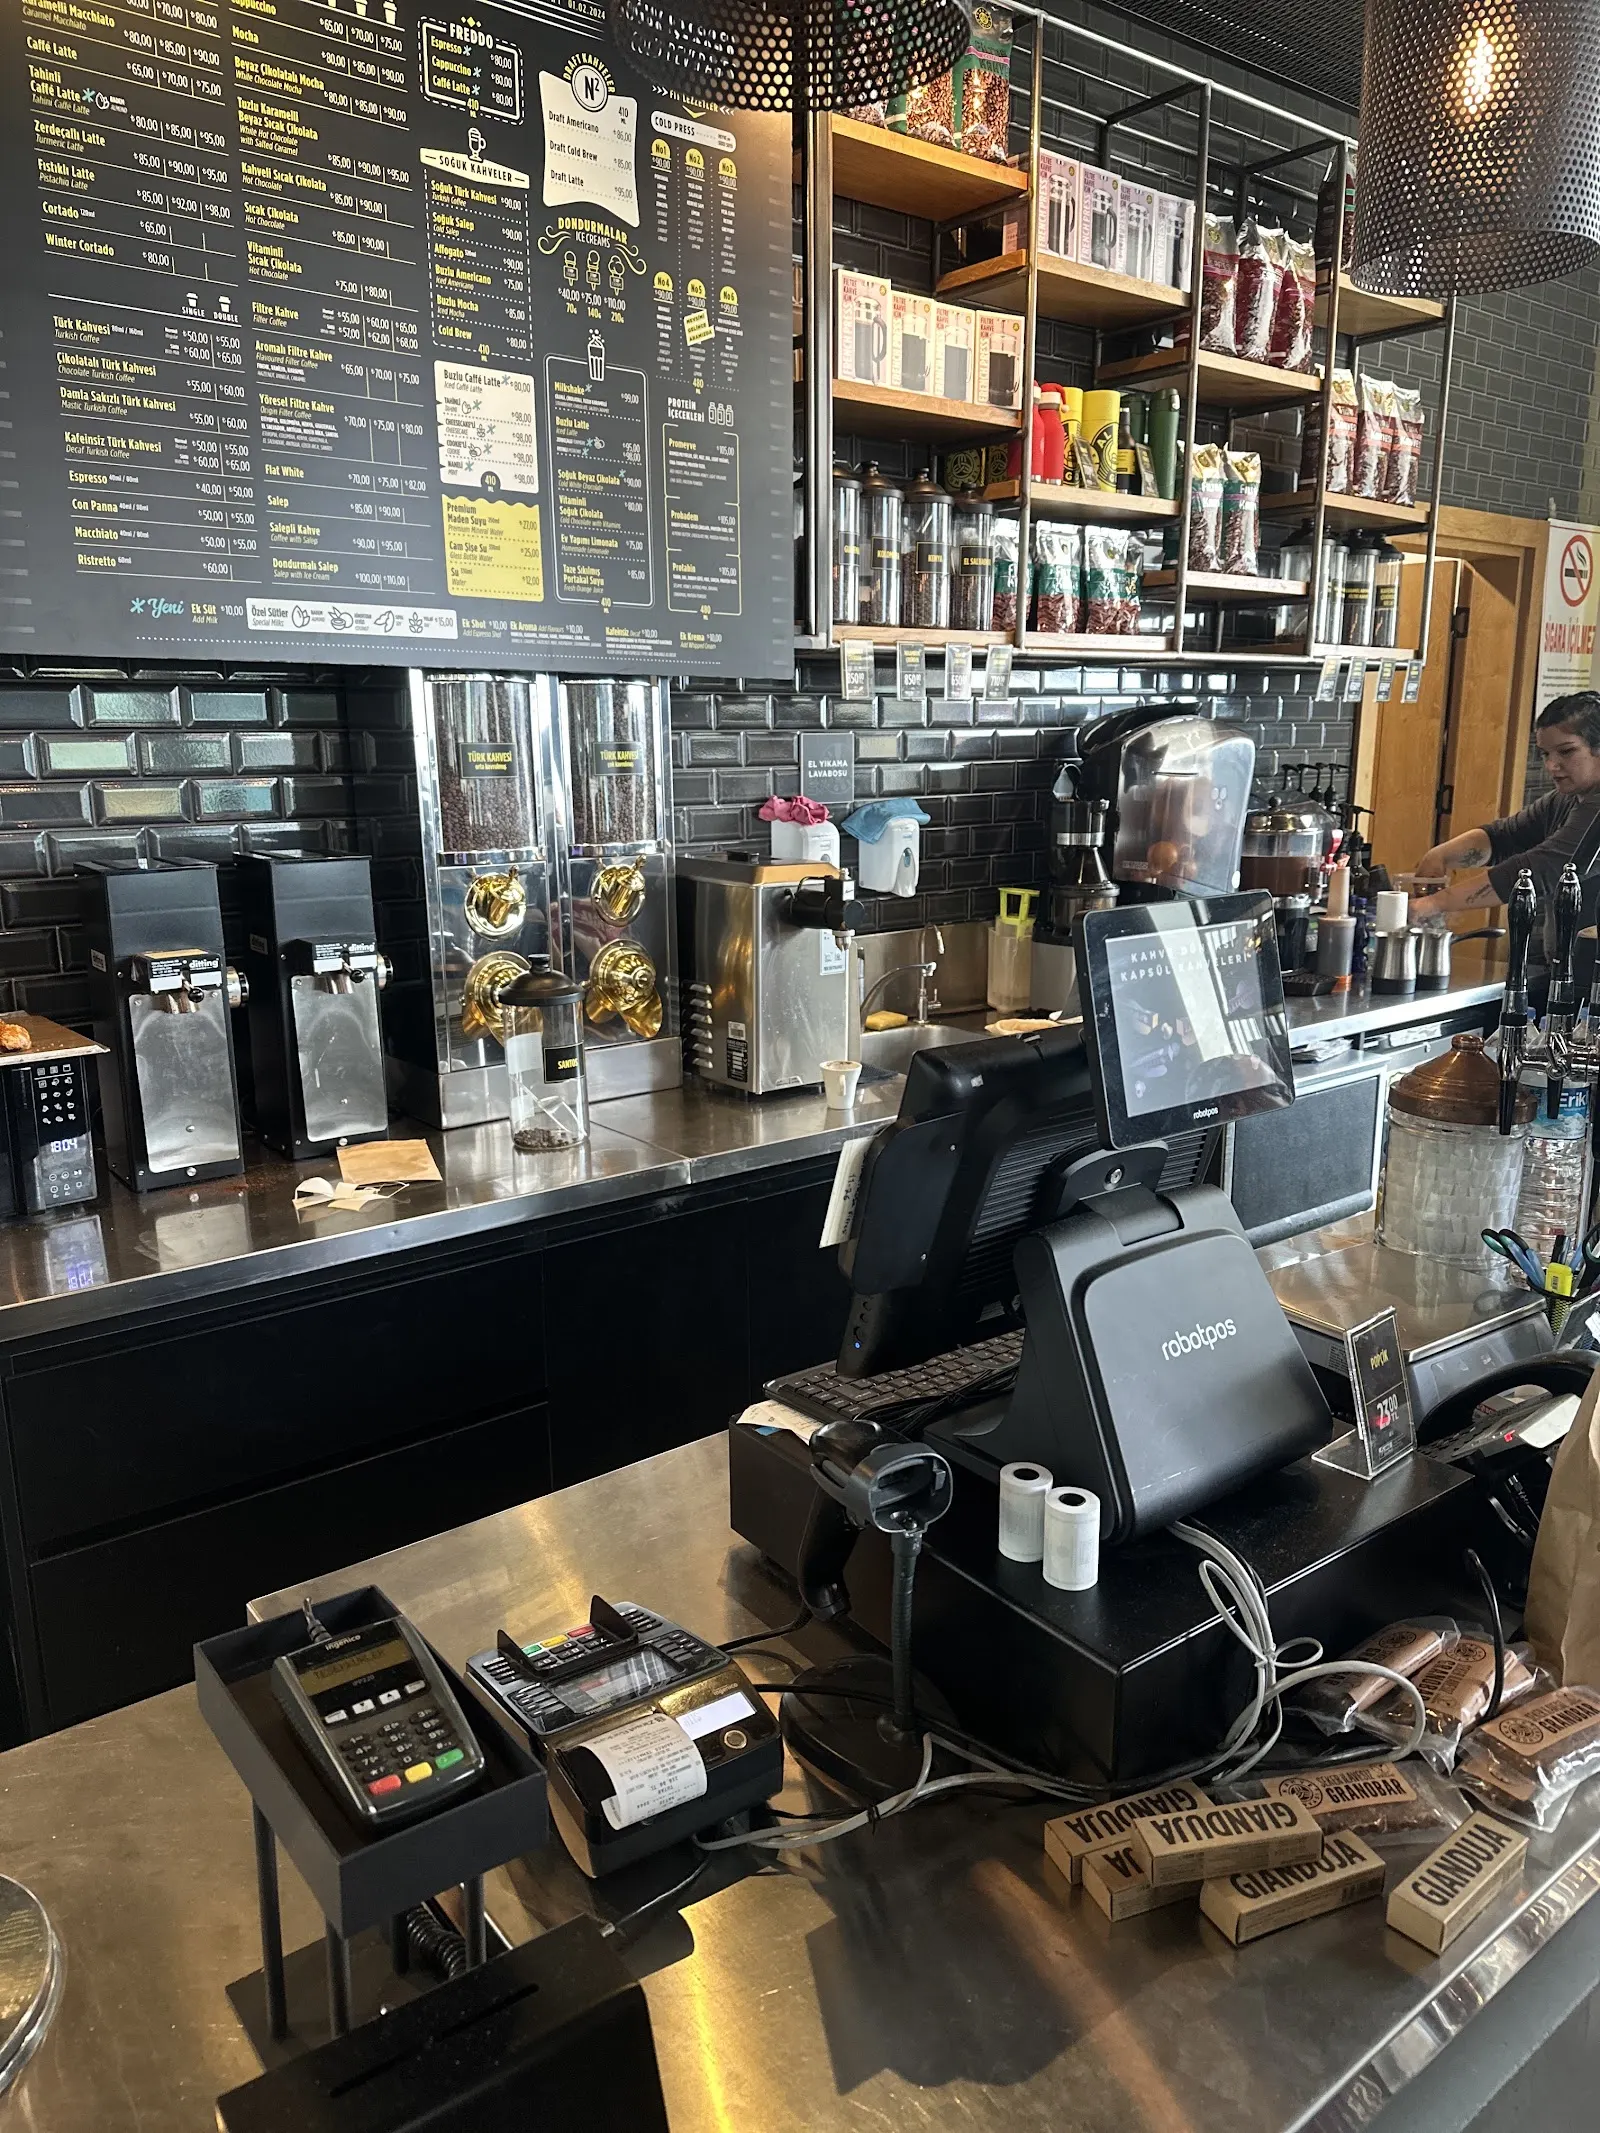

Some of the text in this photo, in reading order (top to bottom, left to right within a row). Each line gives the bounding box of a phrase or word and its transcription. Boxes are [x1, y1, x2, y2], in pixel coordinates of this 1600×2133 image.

[69, 3, 115, 28] Macchiato
[232, 25, 259, 44] Mocha
[450, 24, 494, 49] FREDDO
[53, 42, 78, 60] Latte
[430, 35, 462, 55] Espresso
[28, 64, 61, 84] Tahinli
[234, 56, 259, 74] Beyaz
[300, 72, 324, 90] Mocha
[431, 55, 472, 76] Cappuccino
[562, 52, 616, 94] DRAFT KAHVELER
[57, 86, 81, 103] Latte
[452, 81, 471, 96] Latte
[237, 96, 299, 122] Tuzlu Karamelli
[238, 110, 263, 128] Beyaz
[286, 121, 318, 141] Çikolata
[548, 109, 599, 134] Draft Americano
[655, 116, 695, 136] COLD PRESS
[33, 119, 106, 148] Zerdeçallı Latte
[549, 139, 598, 162] Draft Cold Brew
[71, 164, 96, 182] Latte
[241, 162, 272, 180] Kahveli
[295, 172, 327, 191] Çikolata
[439, 155, 513, 182] SOĞUK KAHVELER
[550, 169, 584, 187] Draft Latte
[430, 180, 497, 205] Soğuk Türk Kahvesi
[42, 200, 79, 219] Cortado
[432, 212, 475, 231] Soğuk Salep
[557, 216, 628, 245] DONDURMALAR
[45, 232, 115, 257] Winter Cortado
[435, 264, 491, 285] Buzlu Americano
[181, 305, 239, 323] SINGLE DOUBLE
[252, 301, 299, 320] Filtre Kahve
[52, 315, 111, 335] Türk Kahvesi
[438, 324, 472, 340] Cold Brew
[255, 341, 333, 363] Aromalı Filtre Kahve
[56, 351, 157, 376] Çikolatalı Türk Kahvesi
[60, 386, 177, 412] Damla Sakızlı Türk Kahvesi
[258, 393, 335, 414] Yöresel Filtre Kahve
[64, 431, 162, 453] Kafeinsiz Türk Kahvesi
[668, 438, 697, 451] Promeyve
[69, 469, 108, 485] Espresso
[265, 464, 305, 478] Flat White
[71, 498, 118, 513] Con Panna
[267, 495, 289, 508] Salep
[446, 502, 477, 514] Premium
[447, 513, 487, 527] Maden Suyu
[74, 526, 119, 541] Macchiato
[77, 553, 117, 568] Ristretto
[272, 557, 339, 573] Dondurmalı Salep
[147, 597, 184, 618] Yeni
[191, 603, 202, 614] Ek
[251, 604, 289, 618] Özel Sütler
[468, 750, 486, 763] TÜRK
[600, 749, 617, 761] TÜRK
[808, 760, 848, 768] EL YIKAMA
[808, 769, 848, 778] LAVABOSU
[348, 942, 375, 954] ditting
[189, 957, 219, 969] ditting
[1120, 963, 1171, 982] KAPSÜL
[1193, 1106, 1219, 1120] robotpos
[1161, 1316, 1237, 1362] robotpos
[325, 1634, 361, 1651] ingenico
[1325, 1778, 1407, 1804] GRANOBAR
[1150, 1801, 1298, 1846] GIANDUJA
[1411, 1825, 1513, 1907] GIANDUJA
